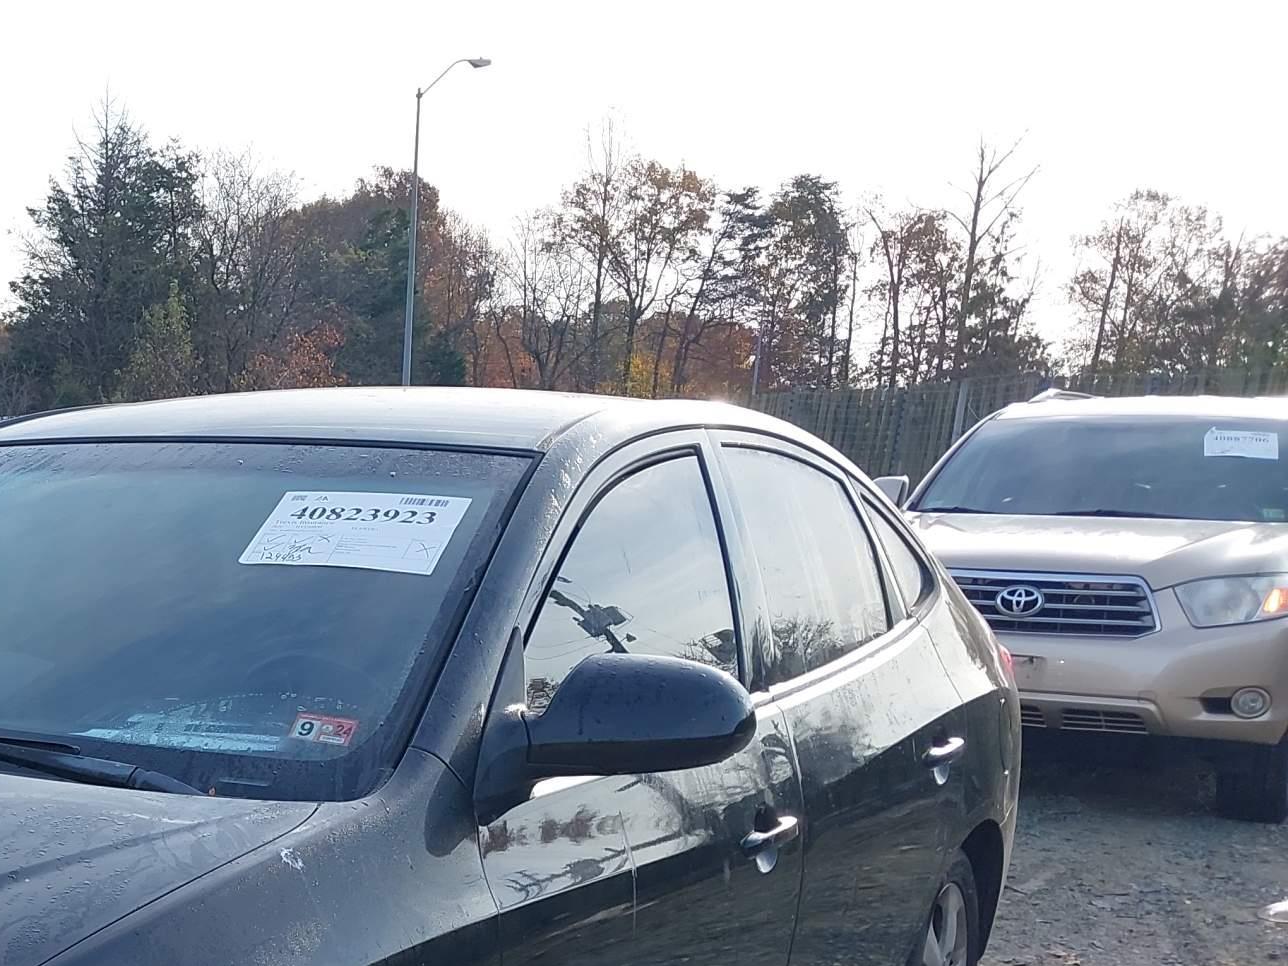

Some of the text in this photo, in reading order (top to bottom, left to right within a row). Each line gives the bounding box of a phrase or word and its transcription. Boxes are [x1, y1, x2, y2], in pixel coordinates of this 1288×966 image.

[290, 505, 437, 525] 40823923
[298, 721, 353, 737] 9 24
